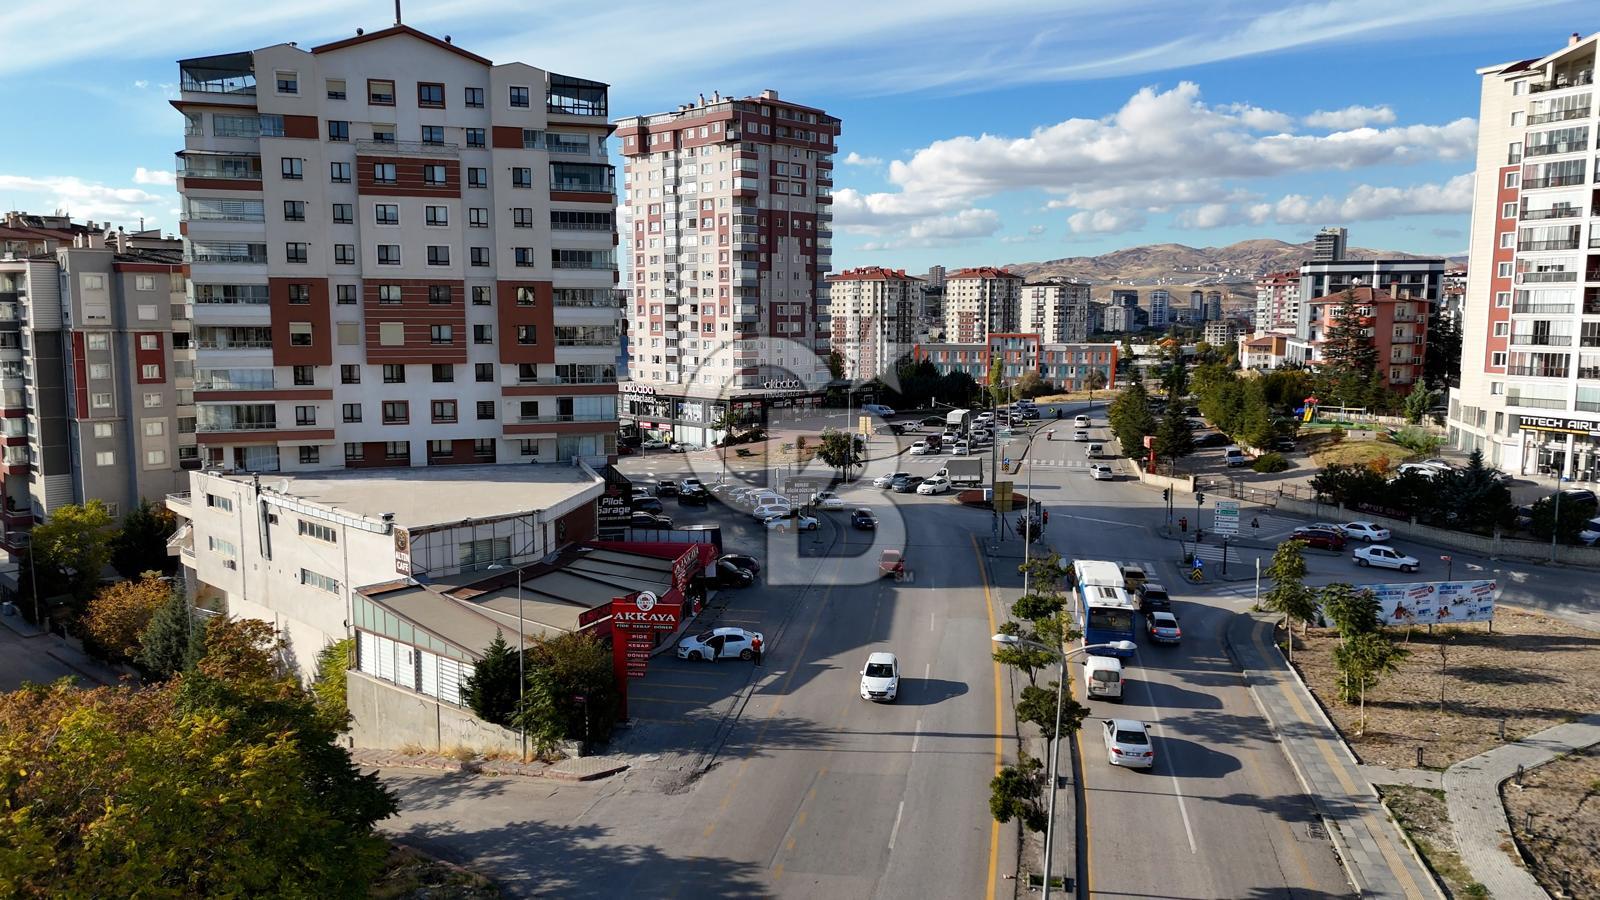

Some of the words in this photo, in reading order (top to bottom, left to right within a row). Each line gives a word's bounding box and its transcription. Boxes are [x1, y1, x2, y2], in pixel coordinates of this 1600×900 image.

[624, 382, 653, 394] akbaba
[764, 378, 800, 389] akbaba
[1520, 416, 1563, 428] TITECH
[1567, 420, 1600, 431] AIRL
[602, 497, 624, 505] Pilot
[397, 561, 409, 572] CAFE
[614, 612, 676, 622] AKKAYA
